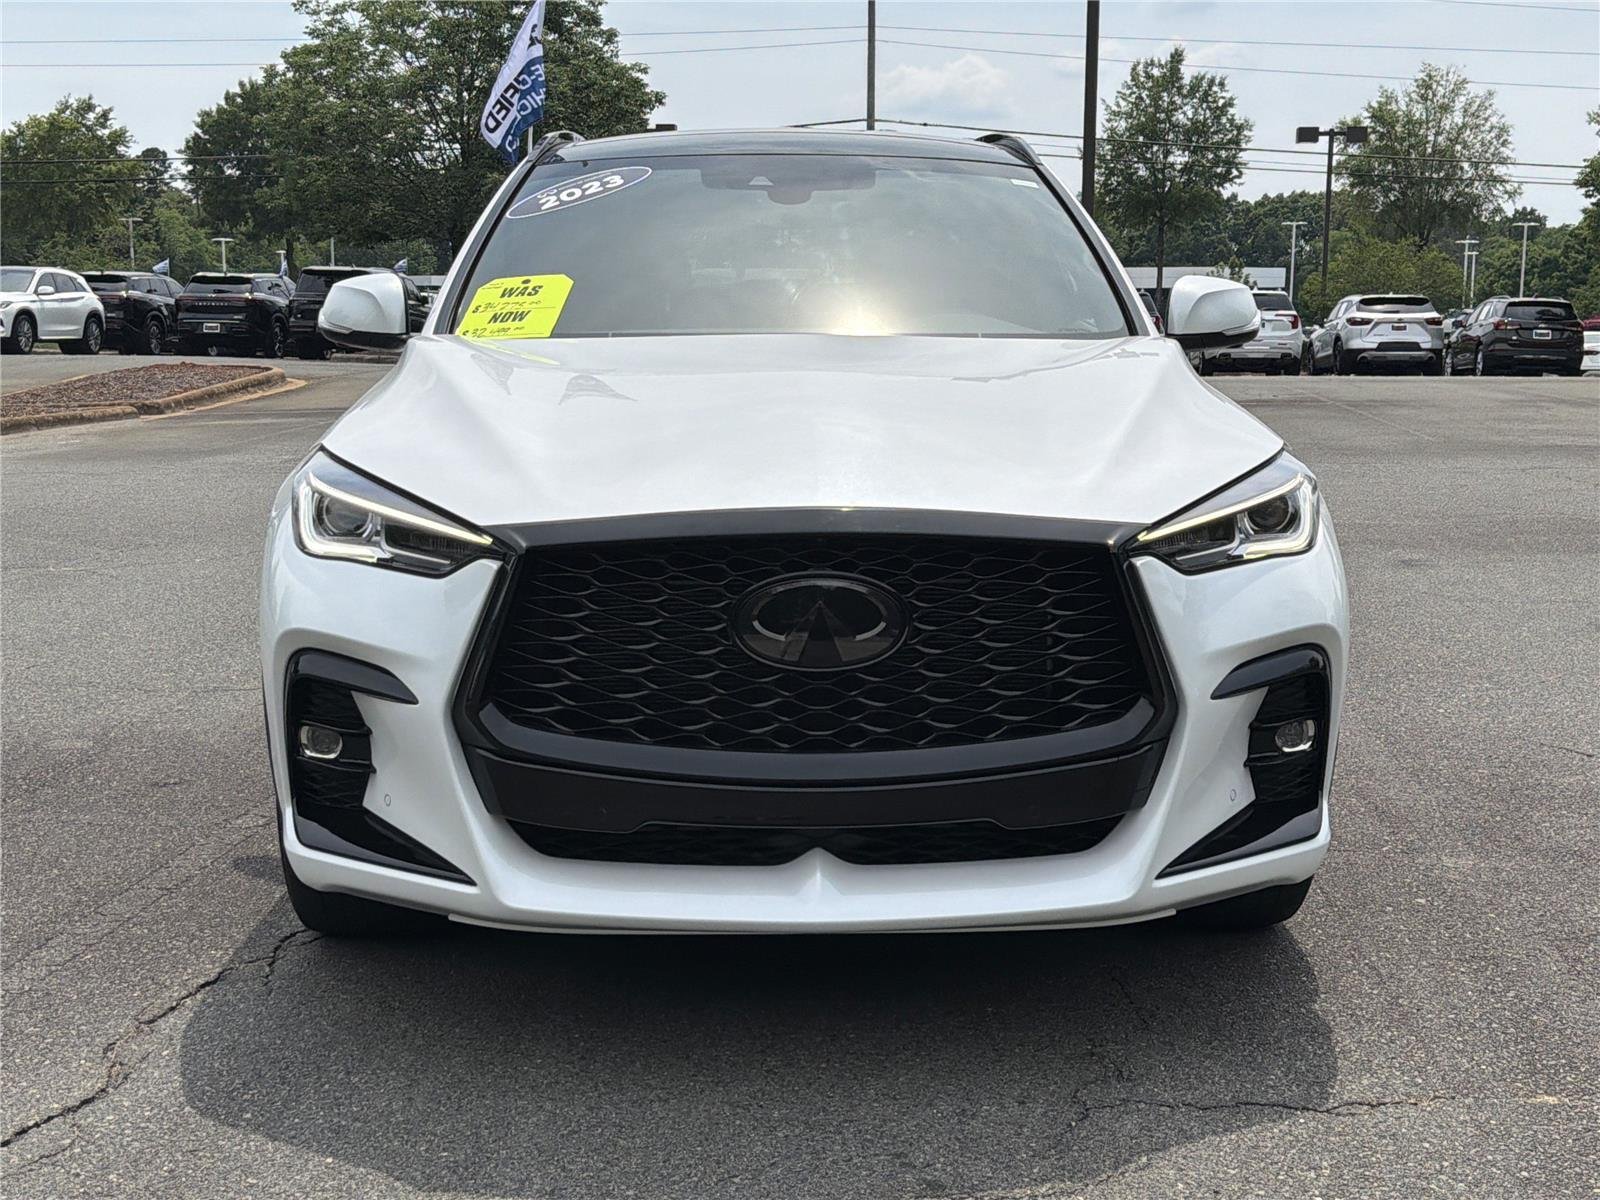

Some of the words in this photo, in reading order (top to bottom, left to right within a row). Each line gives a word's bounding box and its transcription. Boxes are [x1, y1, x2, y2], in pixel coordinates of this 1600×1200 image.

[538, 174, 625, 211] 2023
[499, 285, 544, 298] WAS
[487, 310, 532, 325] NOW
